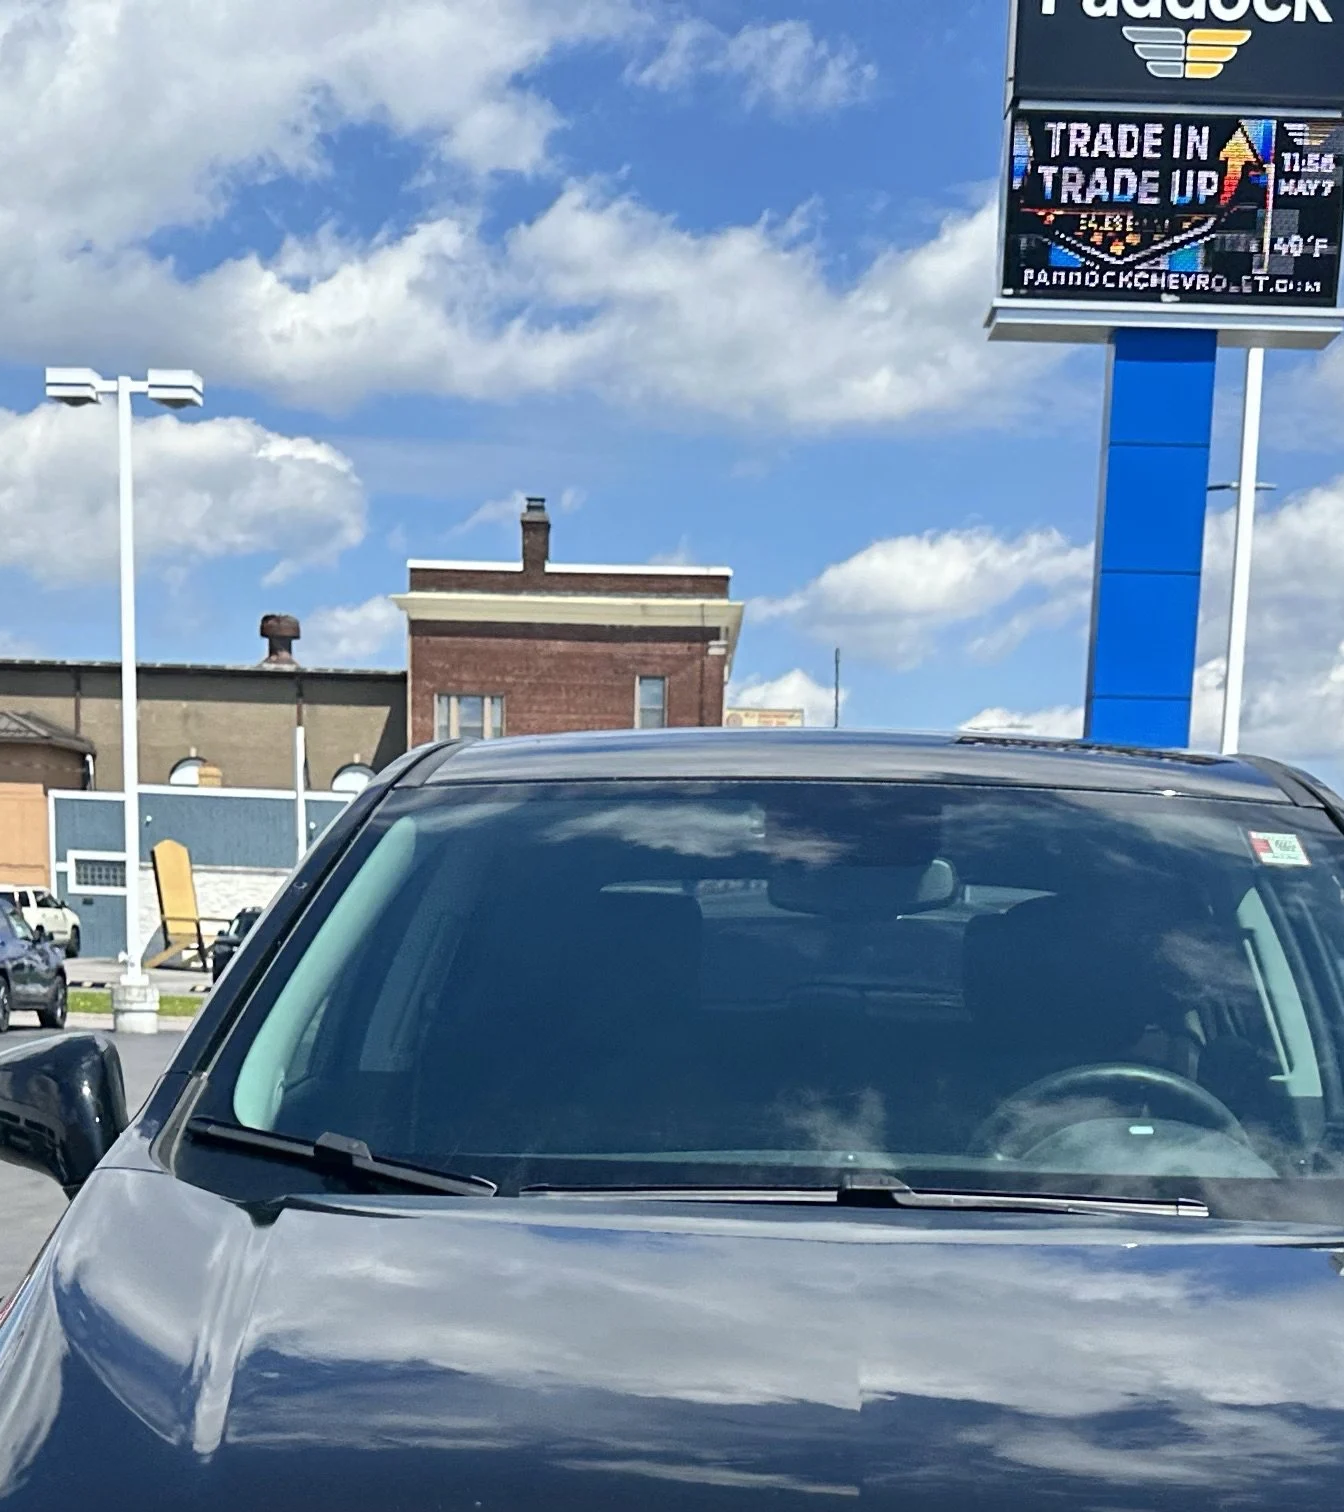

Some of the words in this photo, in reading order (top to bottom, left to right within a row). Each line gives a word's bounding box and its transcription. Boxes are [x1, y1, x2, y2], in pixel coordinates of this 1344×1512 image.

[1044, 121, 1164, 158] TRADE
[1172, 123, 1209, 160] IN
[1037, 165, 1160, 205] TRADE
[1170, 169, 1219, 206] UP
[1278, 178, 1321, 195] MAY
